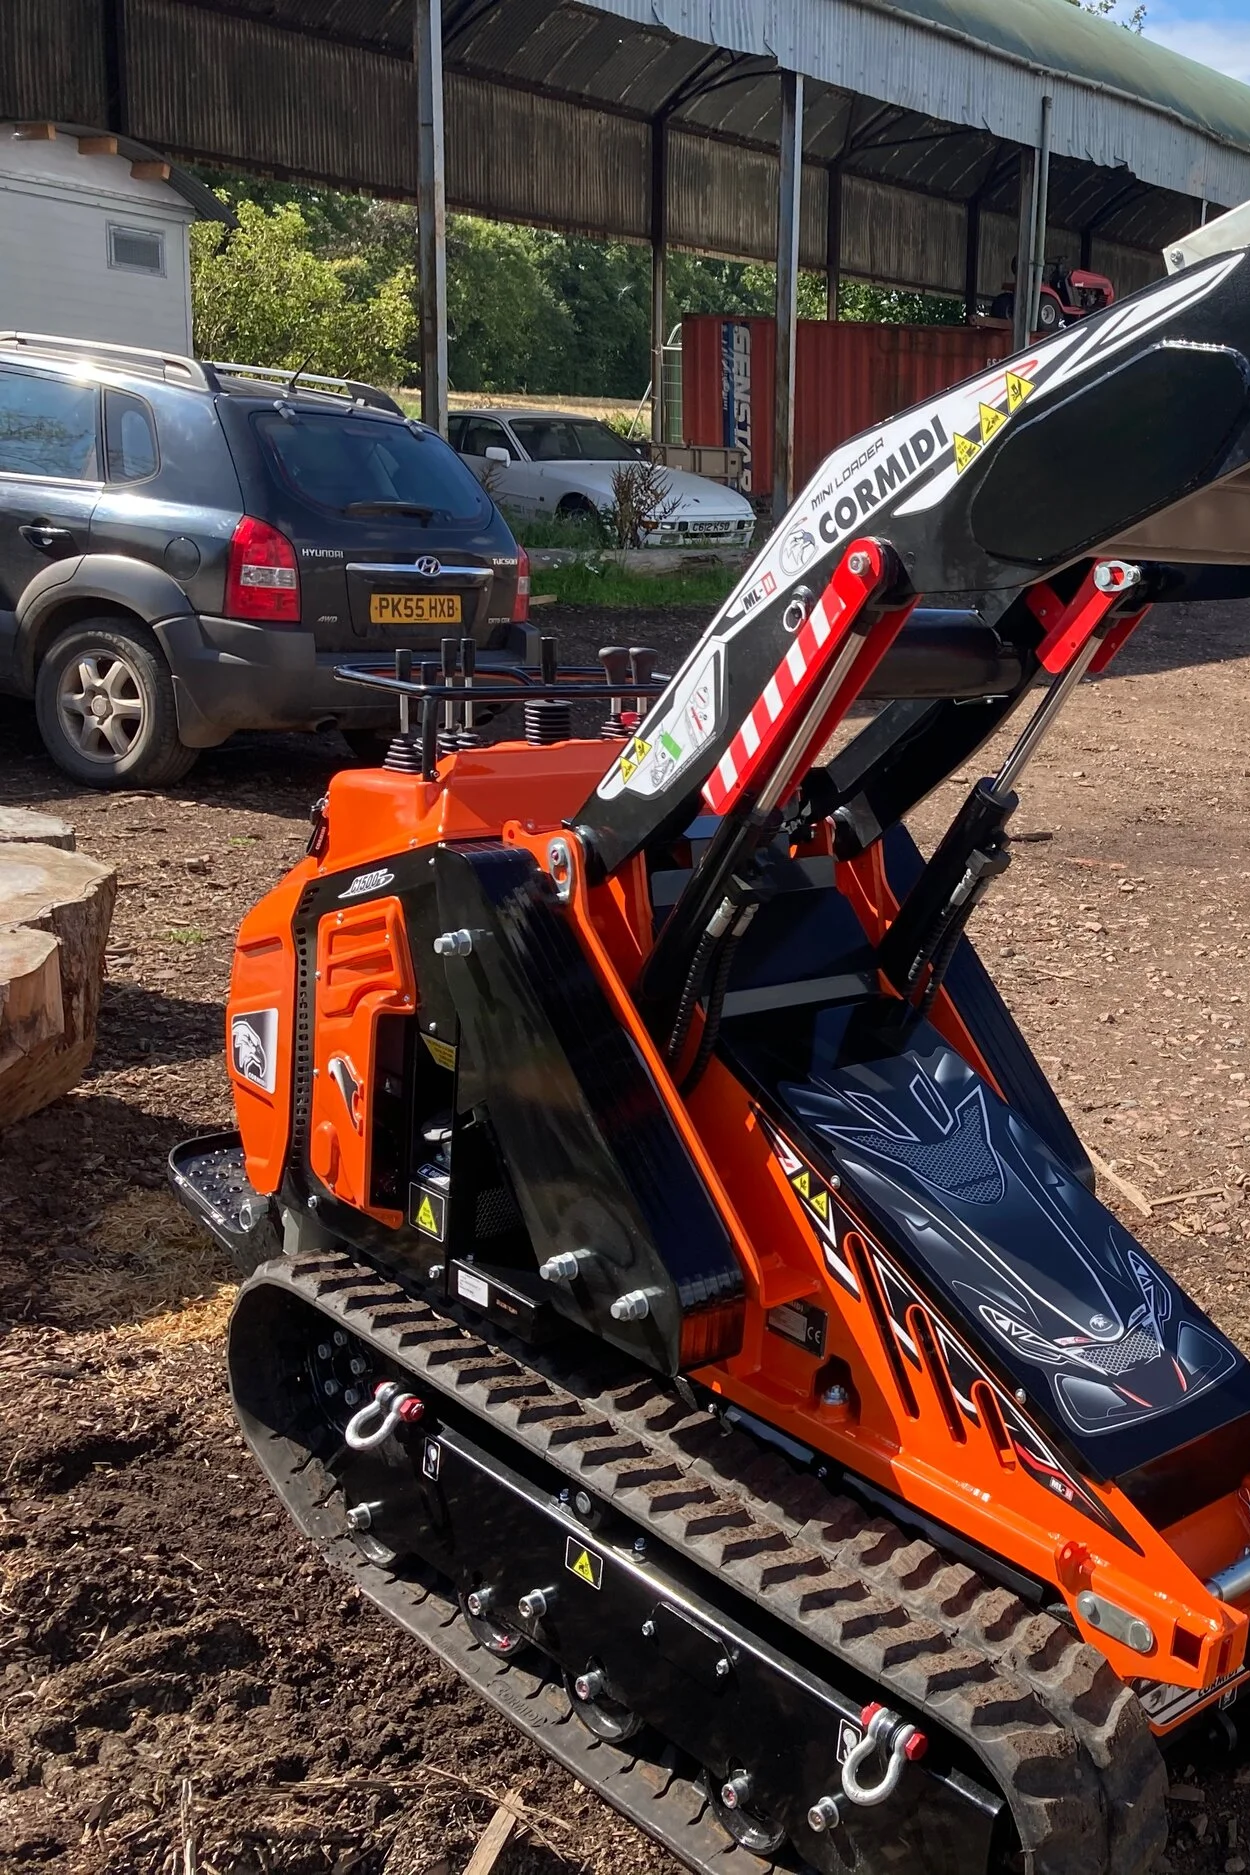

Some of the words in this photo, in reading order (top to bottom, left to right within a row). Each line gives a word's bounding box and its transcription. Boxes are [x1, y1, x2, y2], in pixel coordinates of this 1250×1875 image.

[811, 484, 834, 512] MINI
[835, 436, 885, 489] LOADER
[818, 414, 950, 544] CORMIDI
[301, 548, 344, 559] HYUNDAI
[492, 558, 518, 566] TUCSON
[378, 597, 425, 618] PK55
[428, 598, 455, 618] HXB
[316, 615, 338, 623] AWD
